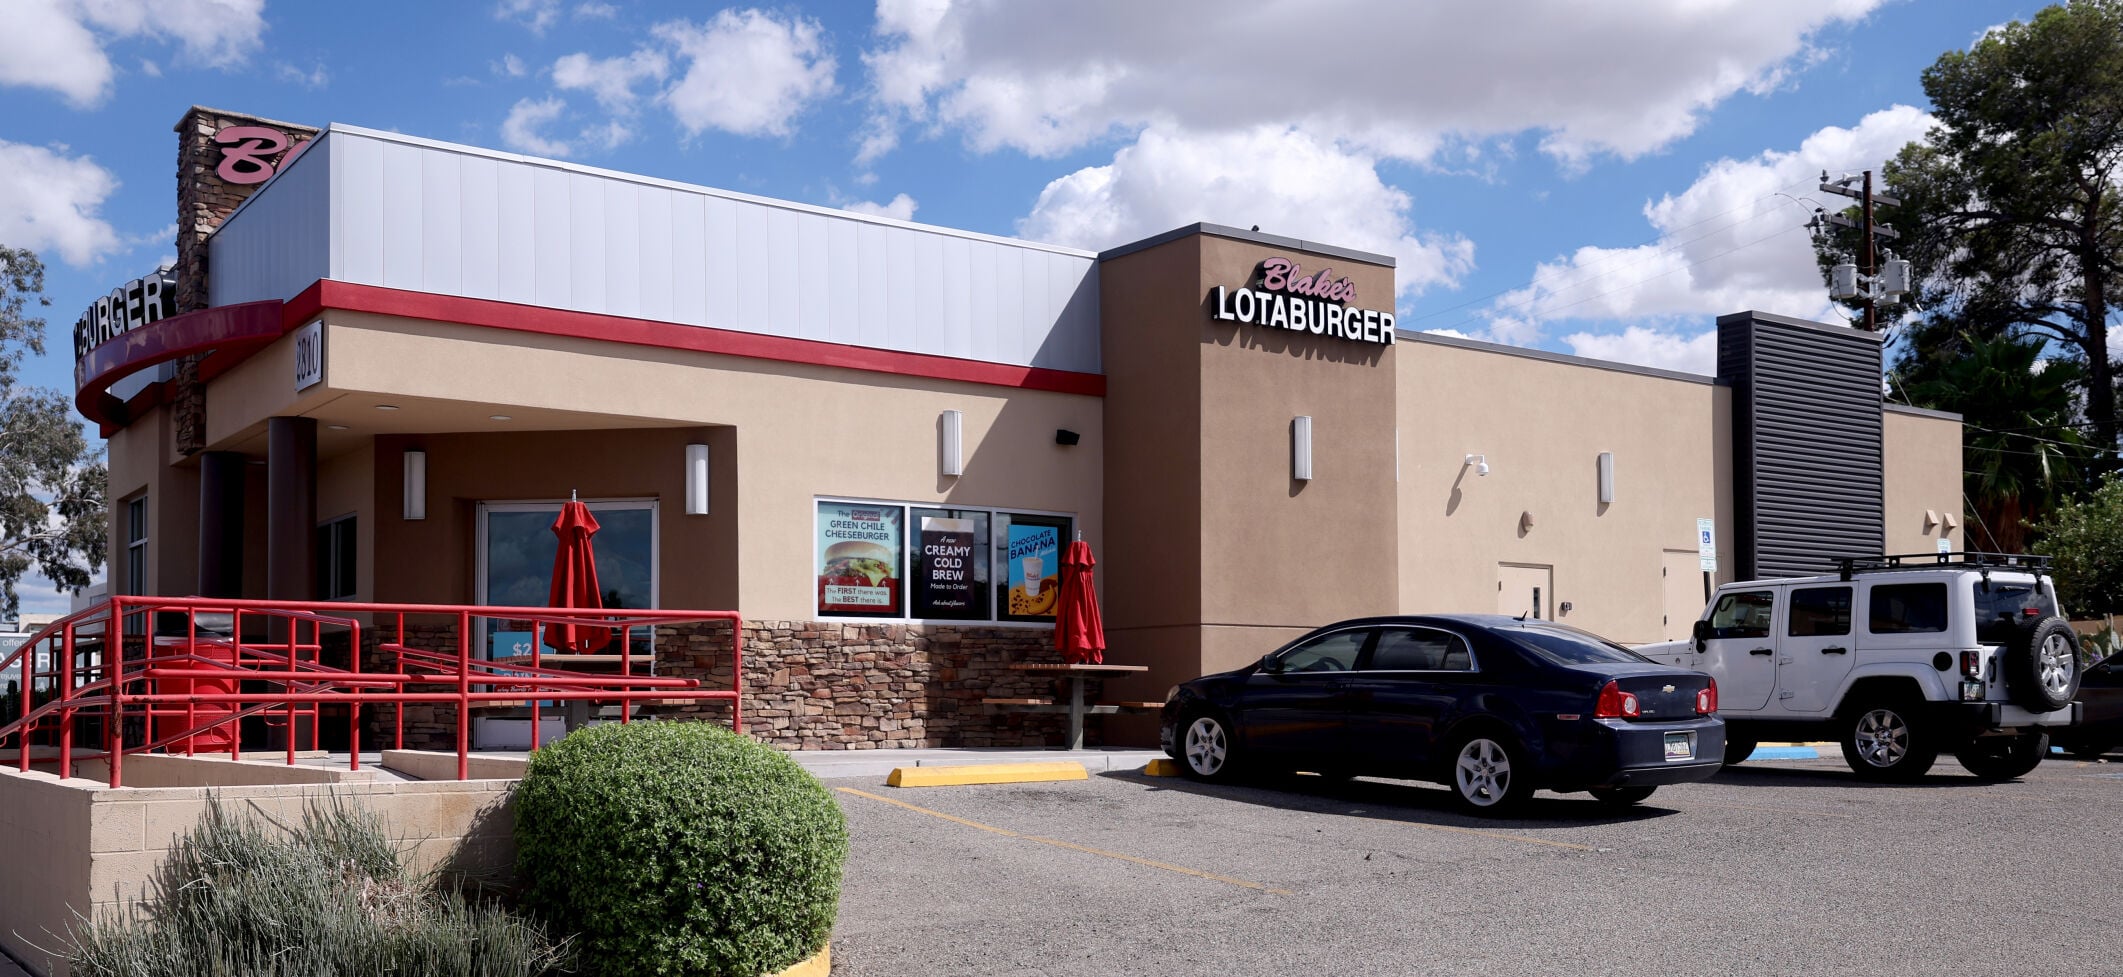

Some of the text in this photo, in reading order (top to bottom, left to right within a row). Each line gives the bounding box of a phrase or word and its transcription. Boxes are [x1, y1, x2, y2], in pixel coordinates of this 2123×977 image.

[1262, 257, 1357, 303] Blake's
[74, 273, 164, 358] BURGER
[1218, 285, 1396, 345] LOTABURGER
[296, 331, 319, 382] 2810
[837, 510, 850, 518] The
[830, 520, 885, 531] GREEN CHILE
[825, 529, 890, 541] CHEESEBURGER
[1011, 529, 1052, 549] CHOCOLATE
[925, 545, 971, 557] CREAMY
[1010, 536, 1056, 560] BANANA
[934, 557, 962, 569] COLD
[932, 570, 964, 581] BREW
[837, 587, 857, 595] FIRST
[930, 582, 946, 590] Made
[952, 583, 968, 591] Order
[842, 595, 859, 603] BEST
